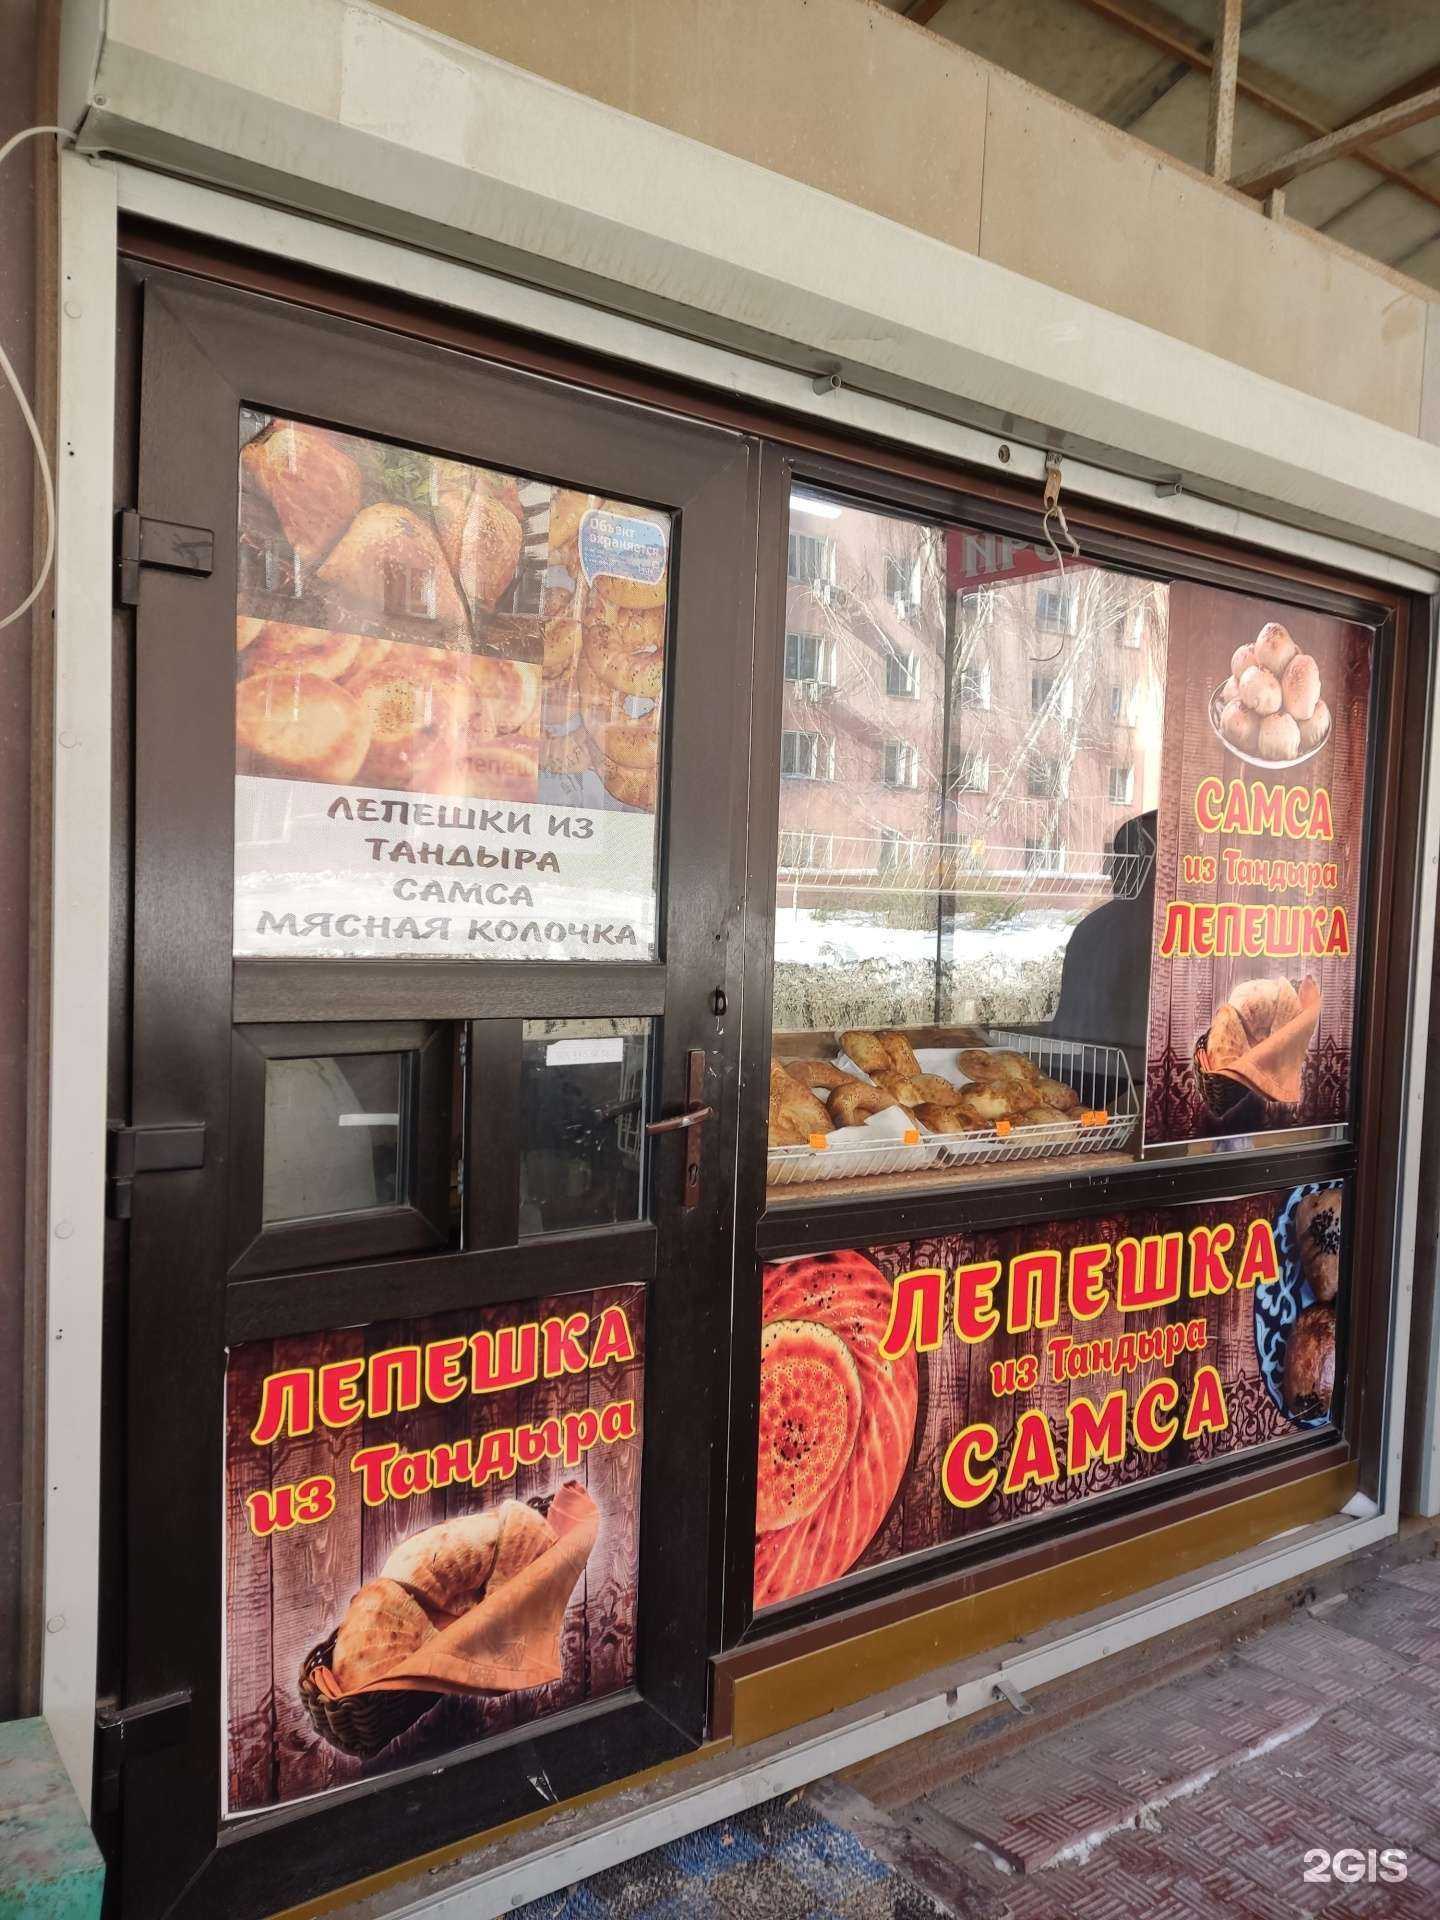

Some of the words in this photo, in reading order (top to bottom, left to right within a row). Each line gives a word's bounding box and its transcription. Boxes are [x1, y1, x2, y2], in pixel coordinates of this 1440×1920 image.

[327, 796, 531, 836] ЛЕПЕШКИ
[547, 814, 595, 840] ИЗ
[1195, 776, 1334, 840] САМСА
[364, 837, 561, 874] ТАНДЫРА
[1183, 855, 1218, 884] из
[1223, 848, 1339, 896] Тандыра
[392, 877, 535, 908] САМСА
[256, 909, 450, 941] МЯСНАЯ
[467, 918, 639, 947] КОЛОЧКА
[1159, 901, 1351, 958] ЛЕПЕШКА
[878, 1218, 1280, 1361] ЛЕПЕШКА
[250, 1304, 636, 1447] ЛЕПЕШКА
[990, 1354, 1039, 1398] из
[1047, 1318, 1208, 1384] Тандыра
[941, 1365, 1230, 1508] САМСА
[246, 1474, 337, 1538] из
[350, 1399, 637, 1507] Тандыра
